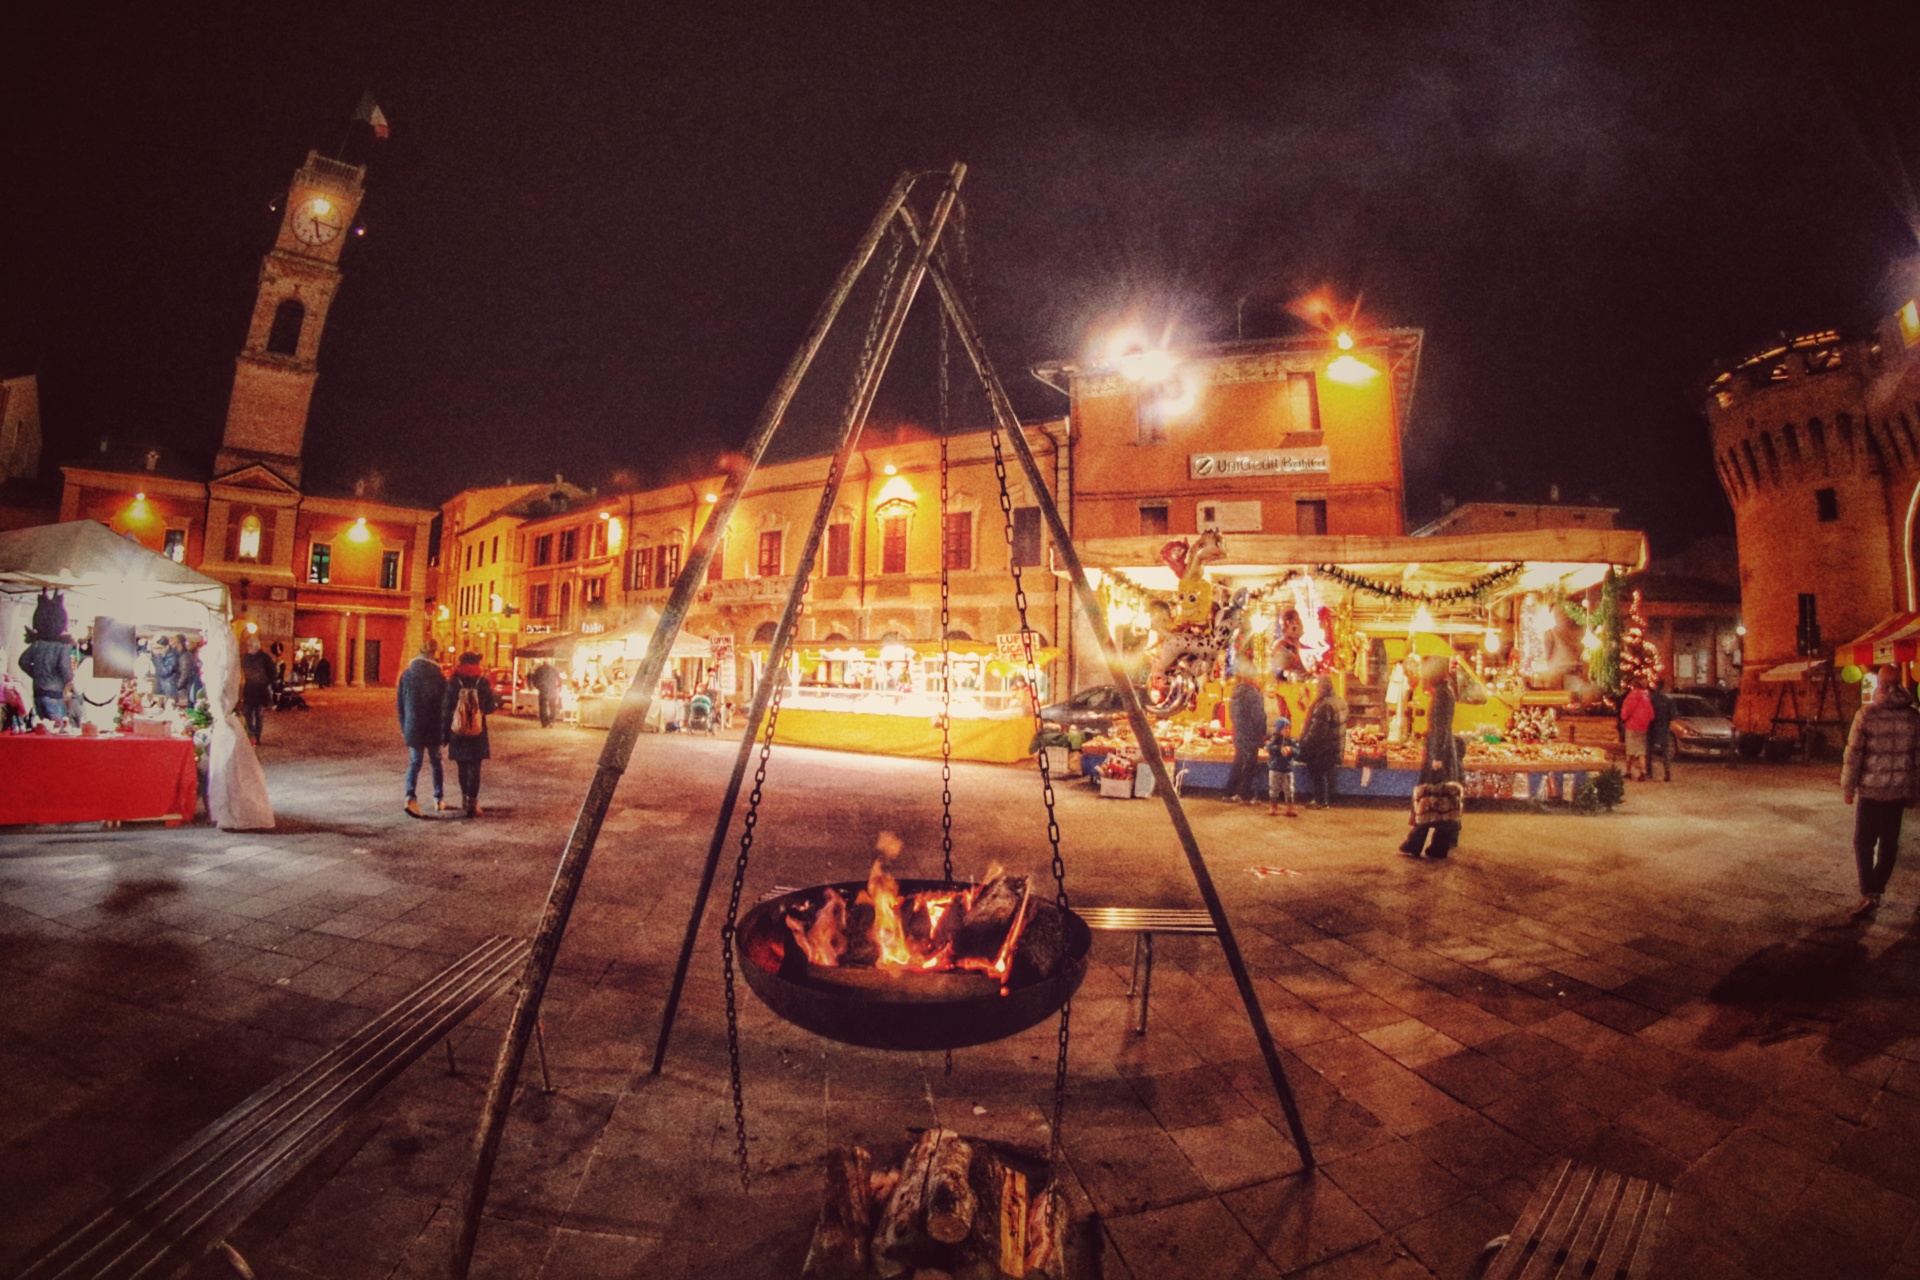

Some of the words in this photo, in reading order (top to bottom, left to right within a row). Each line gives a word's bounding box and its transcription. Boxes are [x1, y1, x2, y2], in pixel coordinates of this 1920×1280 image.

[1217, 456, 1280, 473] UniCredit
[1283, 456, 1326, 470] Banca
[1000, 635, 1036, 644] LUPNI
